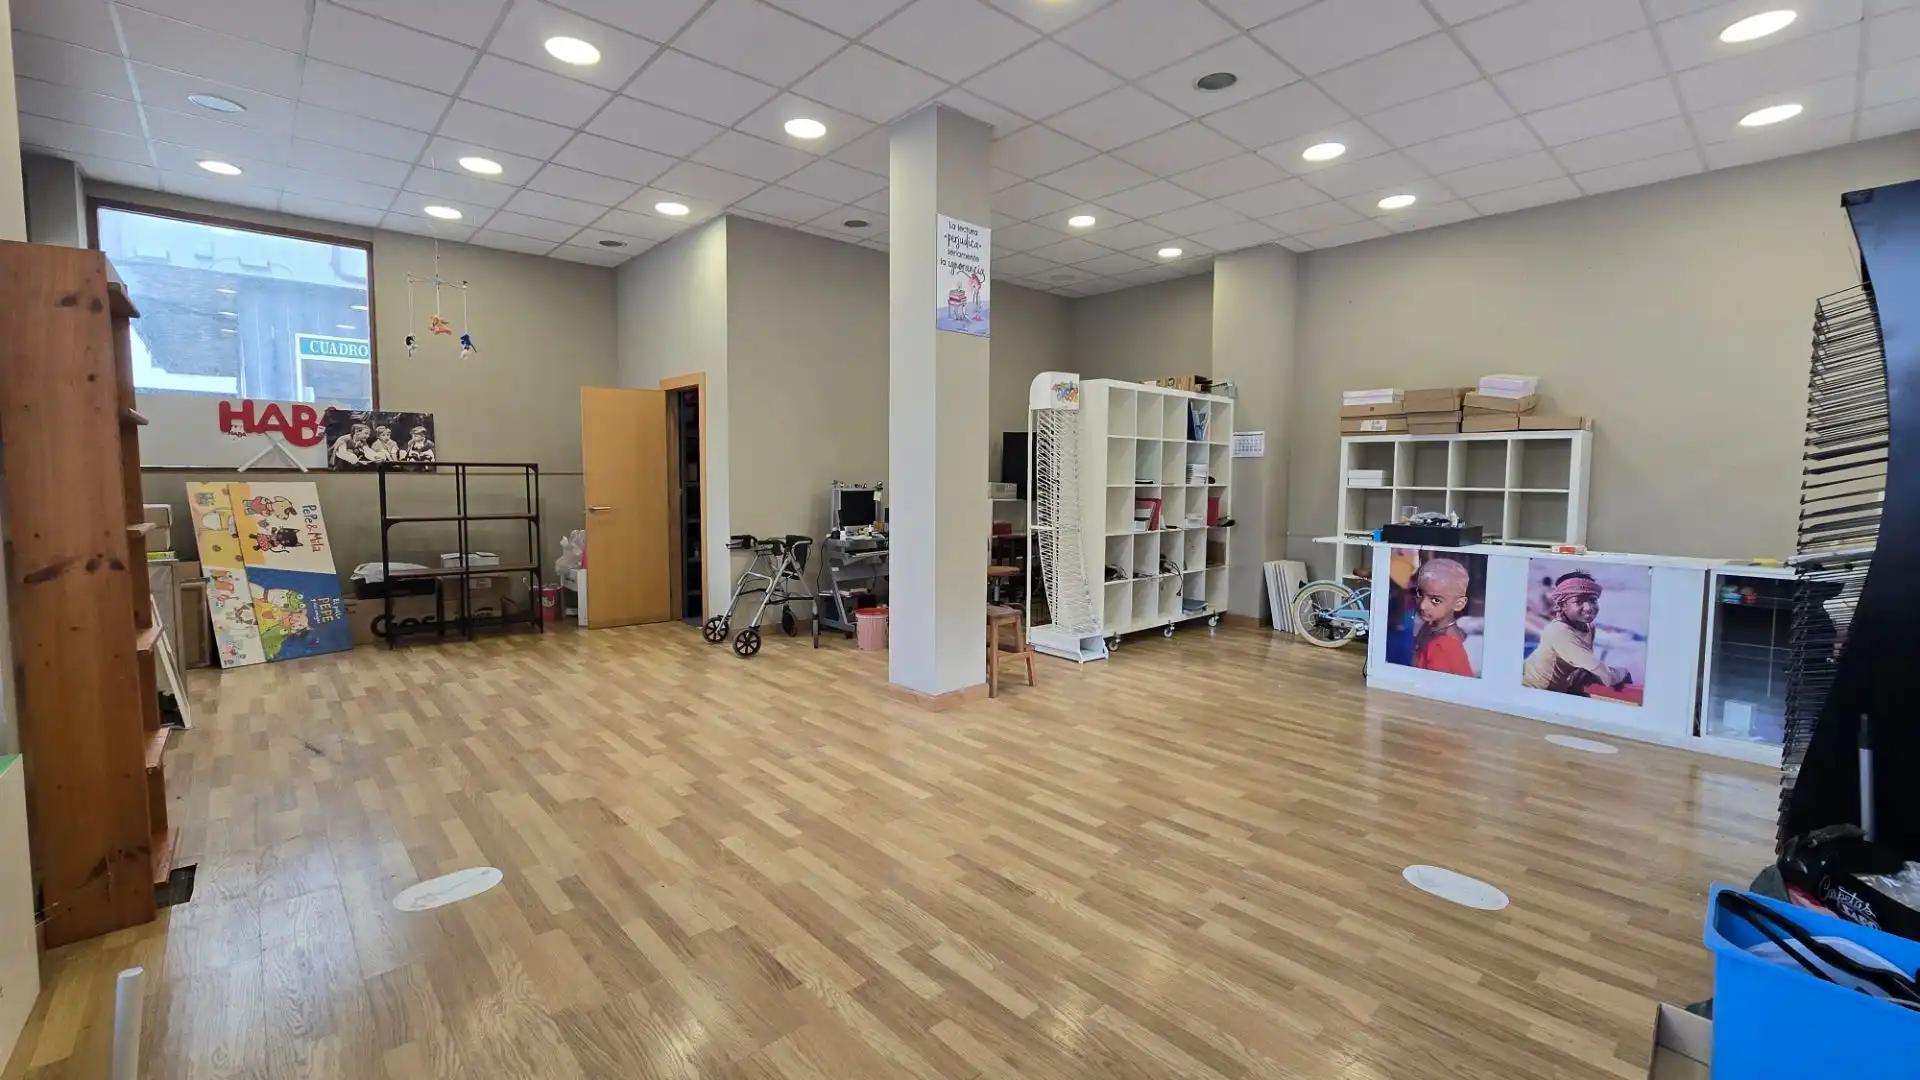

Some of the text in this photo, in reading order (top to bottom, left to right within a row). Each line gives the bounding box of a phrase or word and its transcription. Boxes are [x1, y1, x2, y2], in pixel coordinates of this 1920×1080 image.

[957, 223, 979, 236] lectura
[940, 257, 947, 266] la
[309, 340, 368, 357] CUADRO
[219, 399, 336, 447] HAB
[307, 532, 324, 552] Mila
[318, 597, 334, 623] PEPE
